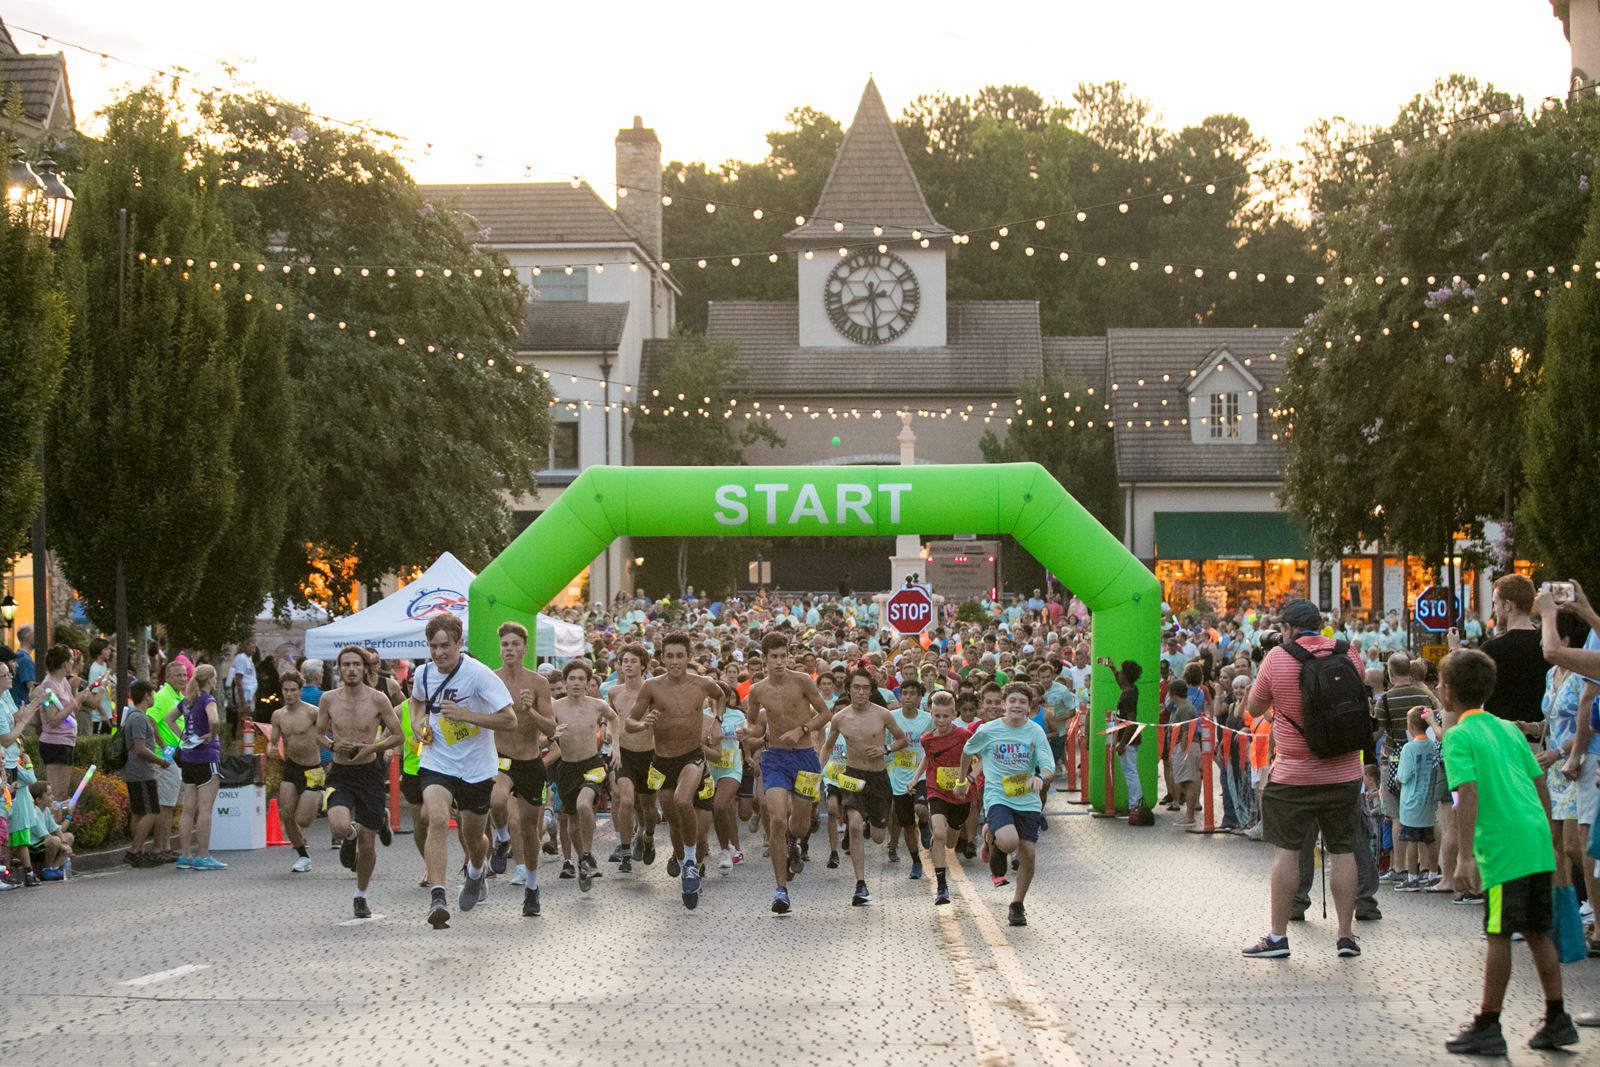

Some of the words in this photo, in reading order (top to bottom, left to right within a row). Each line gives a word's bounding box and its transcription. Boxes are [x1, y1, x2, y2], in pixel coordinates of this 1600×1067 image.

[714, 483, 912, 525] START
[890, 603, 929, 620] STOP
[1420, 600, 1457, 617] STO
[334, 638, 429, 649] www.Performanc
[454, 727, 469, 740] 293
[218, 791, 240, 799] ONLY
